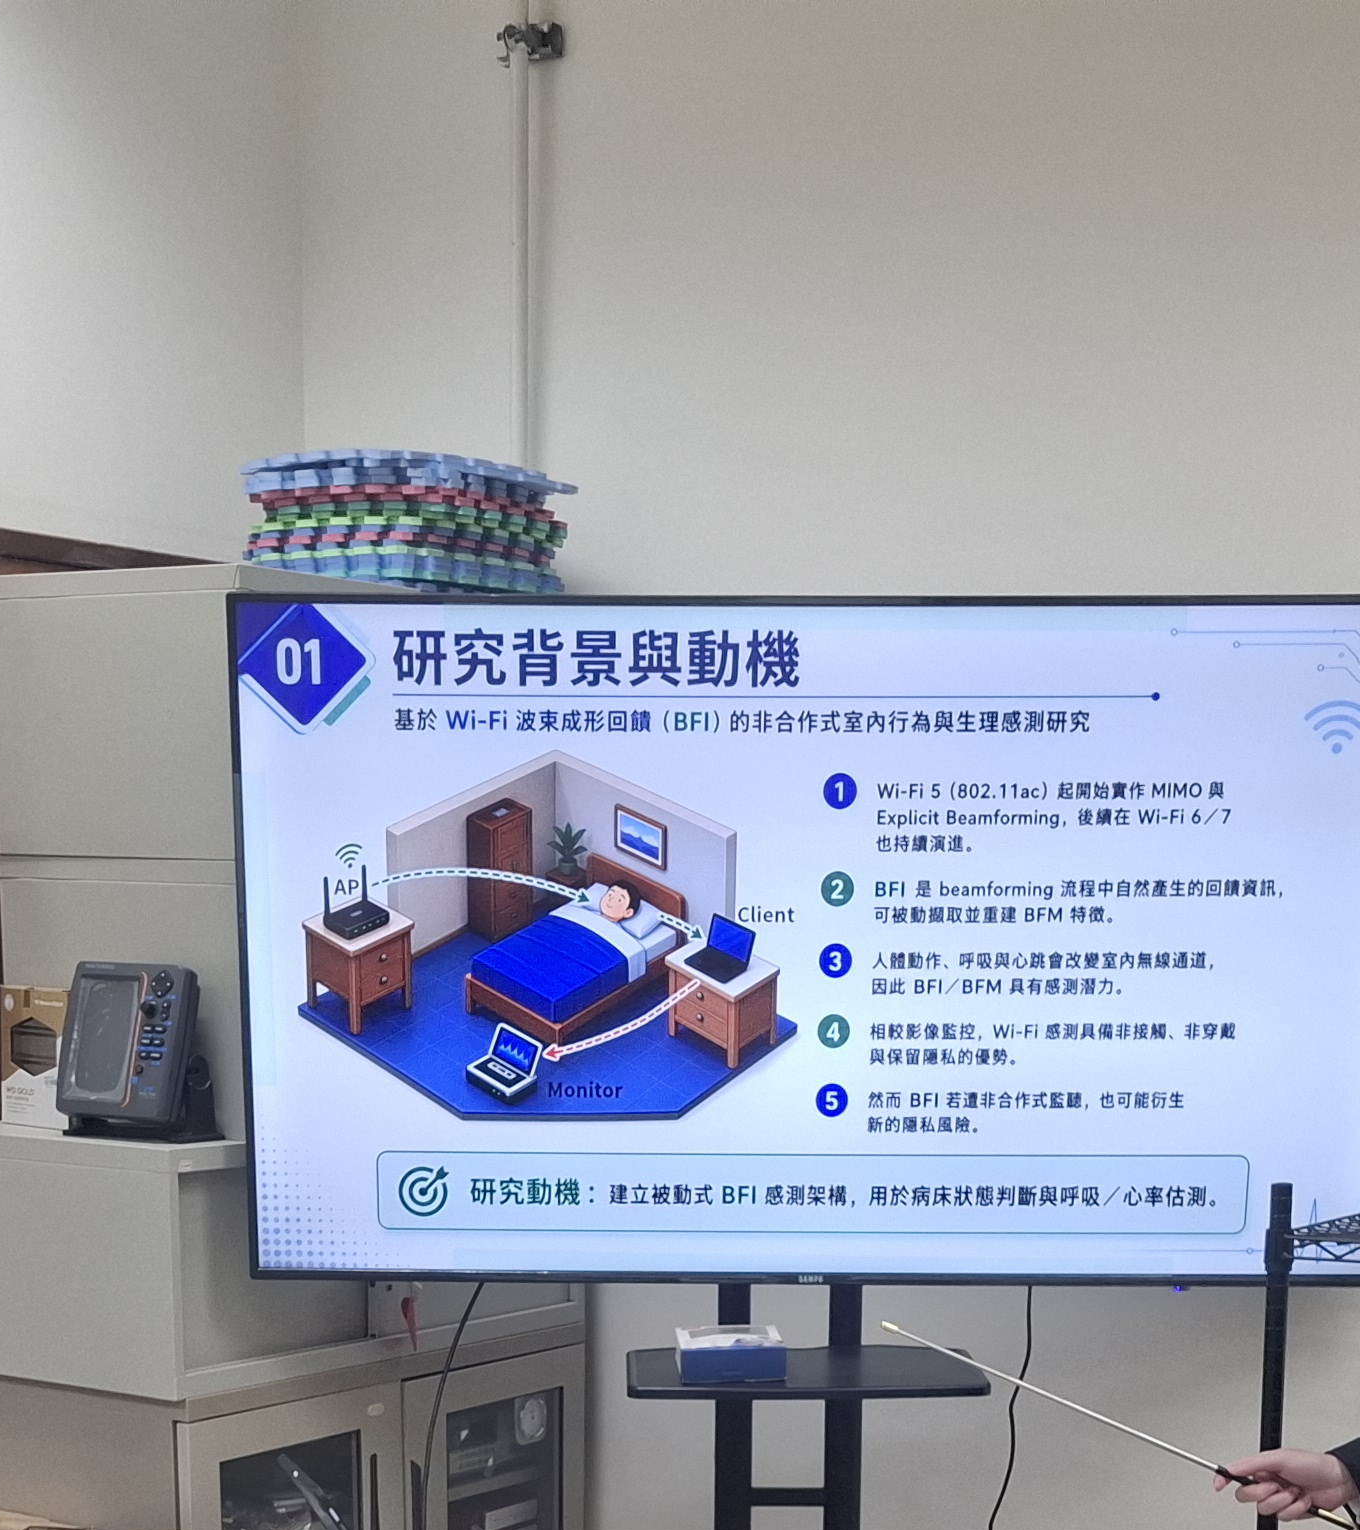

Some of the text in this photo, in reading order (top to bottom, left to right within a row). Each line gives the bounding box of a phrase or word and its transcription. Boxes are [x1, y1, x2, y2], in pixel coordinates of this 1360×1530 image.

[276, 627, 800, 689] 01 研究背景與動機
[394, 707, 438, 731] 基於
[445, 709, 508, 731] Wi-Fi
[877, 782, 924, 800] Wi-Fi
[930, 782, 941, 800] 5
[1151, 782, 1203, 799] MIMO
[1208, 780, 1225, 800] 與
[876, 808, 940, 830] Explicit
[1077, 807, 1131, 827] 後續在
[1137, 808, 1185, 825] Wi-Fi
[875, 834, 975, 853] 也持續演進。
[334, 878, 360, 896] AP
[874, 880, 906, 898] BFI
[915, 879, 932, 899] 是
[939, 880, 1054, 901] beamforming
[737, 905, 796, 924] Client
[1024, 906, 1063, 923] BFM
[1069, 905, 1116, 924] 特徵。
[871, 977, 906, 996] 因此
[1008, 977, 1124, 996] 具有感測潛力。
[992, 1023, 1039, 1040] Wi-Fi
[869, 1047, 1019, 1066] 與保留隱私的優勢。
[547, 1081, 624, 1100] Monitor
[868, 1091, 902, 1109] 然而
[910, 1092, 939, 1109] BFI
[867, 1115, 980, 1134] 新的隱私風險。
[609, 1183, 714, 1206] 建立被動式
[721, 1185, 757, 1205] BFI
